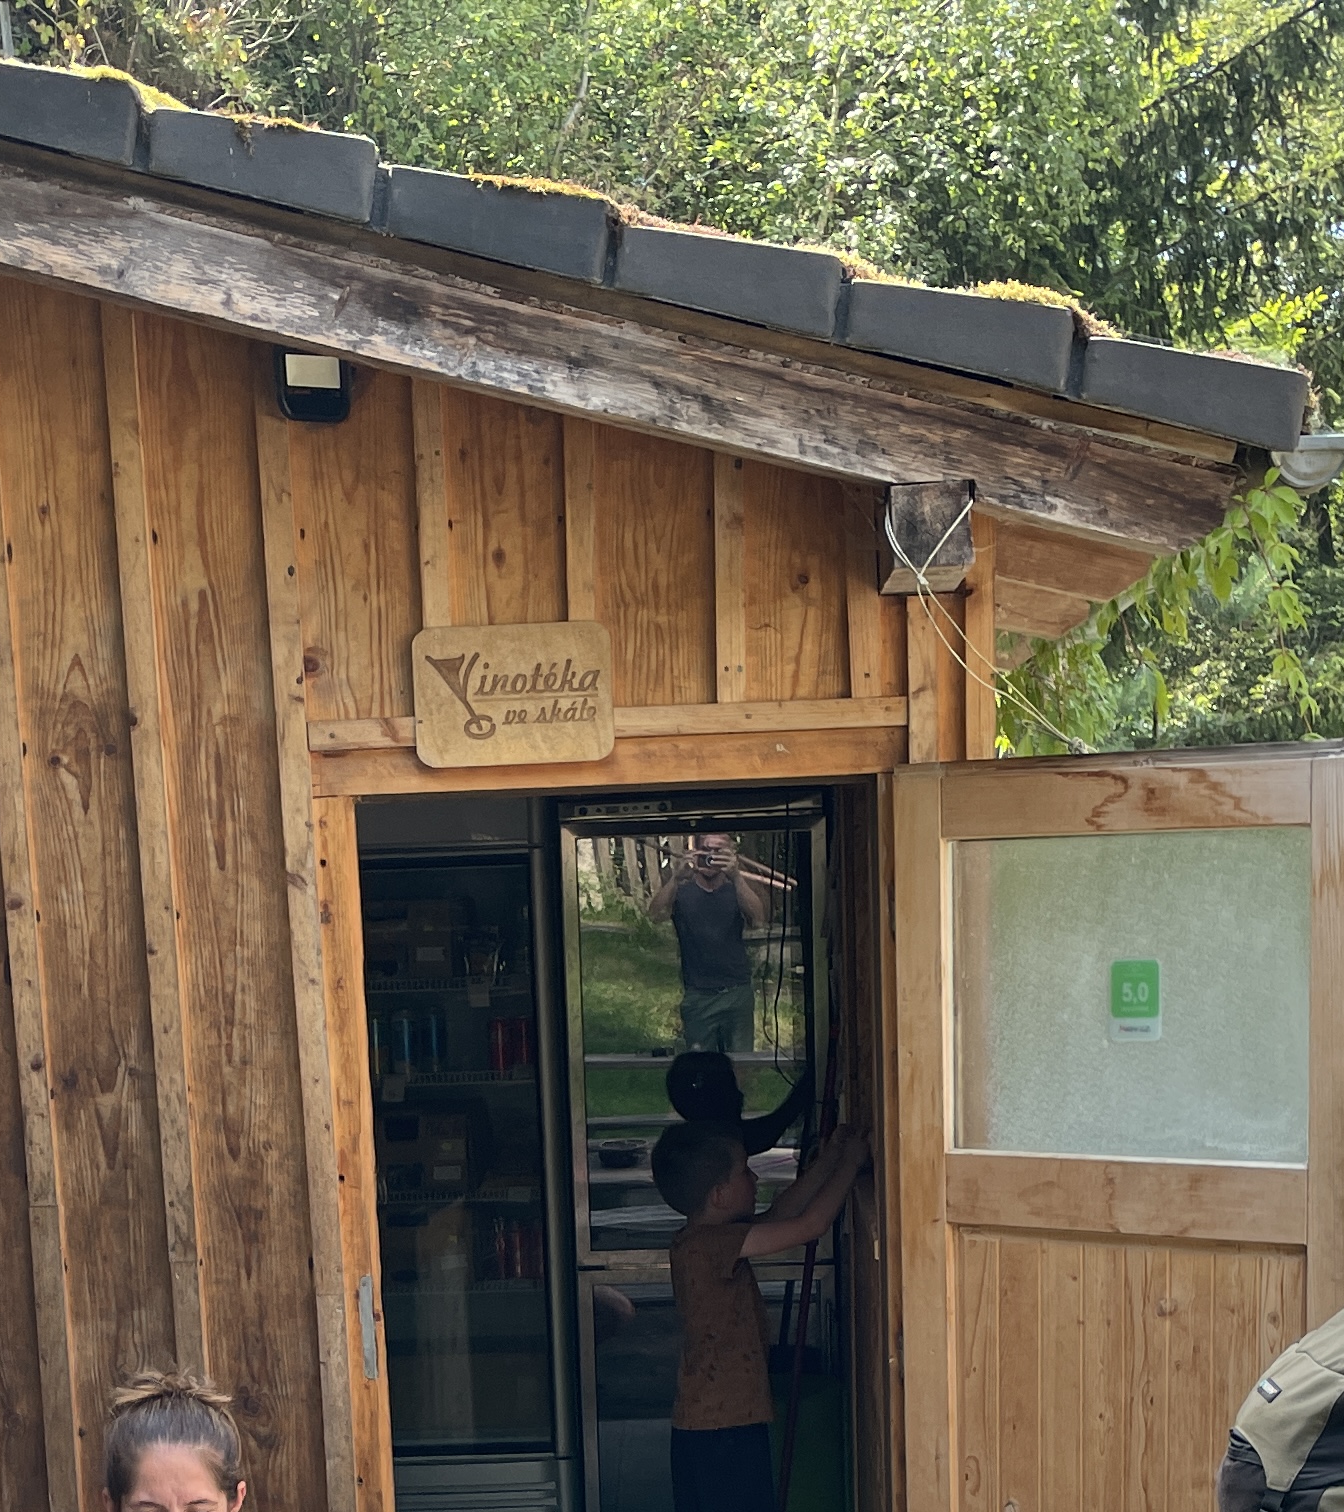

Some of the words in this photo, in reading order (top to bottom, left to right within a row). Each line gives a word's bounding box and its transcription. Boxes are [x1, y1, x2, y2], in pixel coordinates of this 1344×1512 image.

[424, 651, 601, 716] Vinotéka
[502, 708, 527, 726] ve
[533, 698, 598, 725] skále
